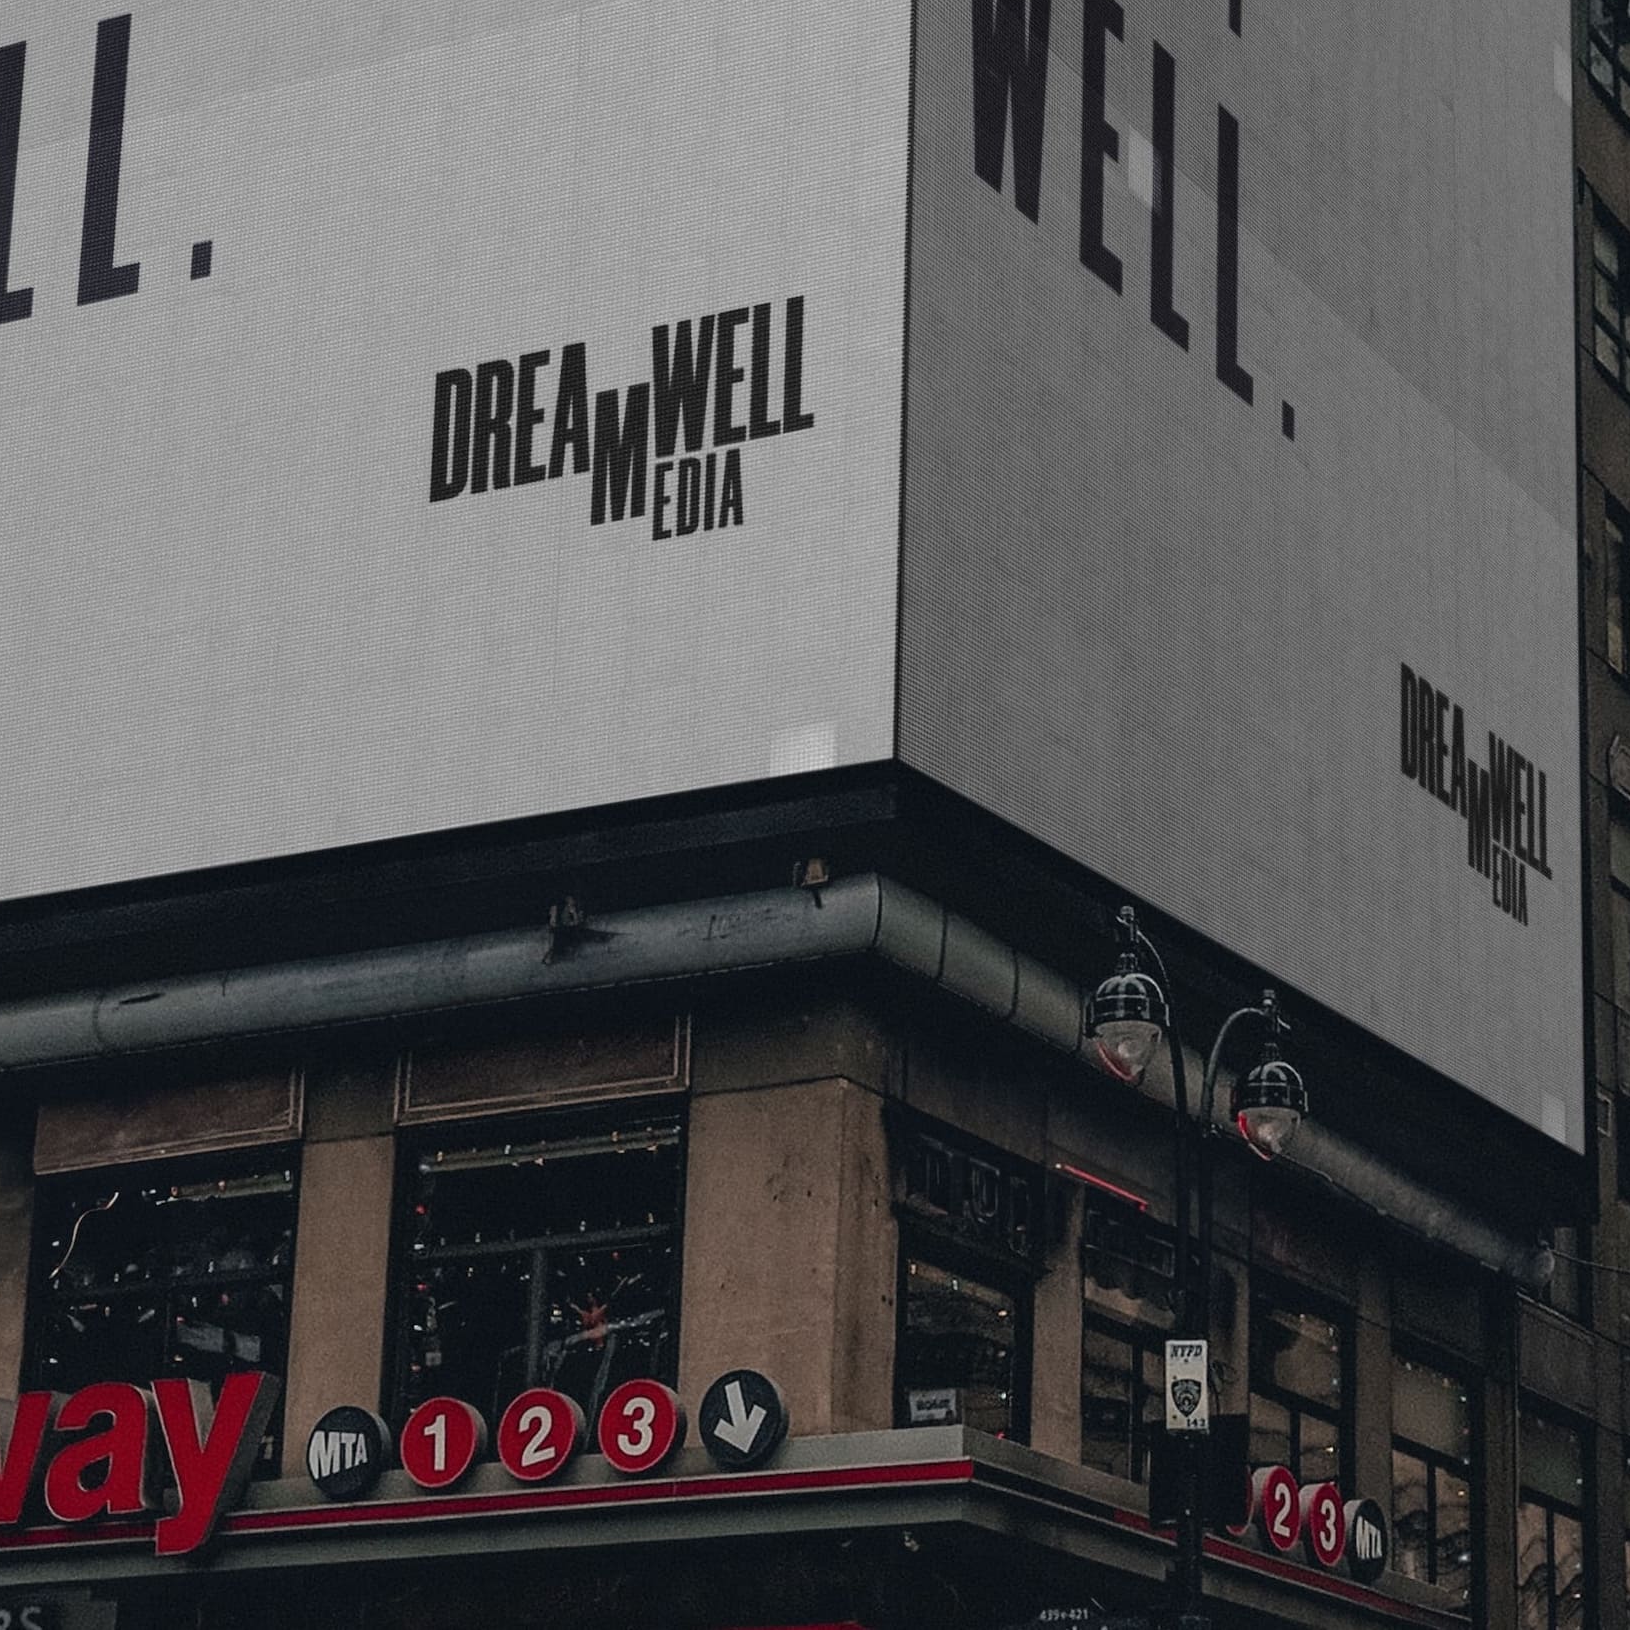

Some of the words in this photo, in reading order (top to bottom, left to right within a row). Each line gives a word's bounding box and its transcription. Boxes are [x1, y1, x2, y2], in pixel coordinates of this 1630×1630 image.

[1171, 1345, 1203, 1358] NYPD
[308, 1429, 369, 1481] MTA
[422, 1414, 447, 1471] 1
[517, 1404, 557, 1468] 2
[617, 1396, 657, 1457] 3
[1273, 1481, 1292, 1538] 2
[1319, 1498, 1337, 1552] 3
[1355, 1514, 1383, 1561] MTA
